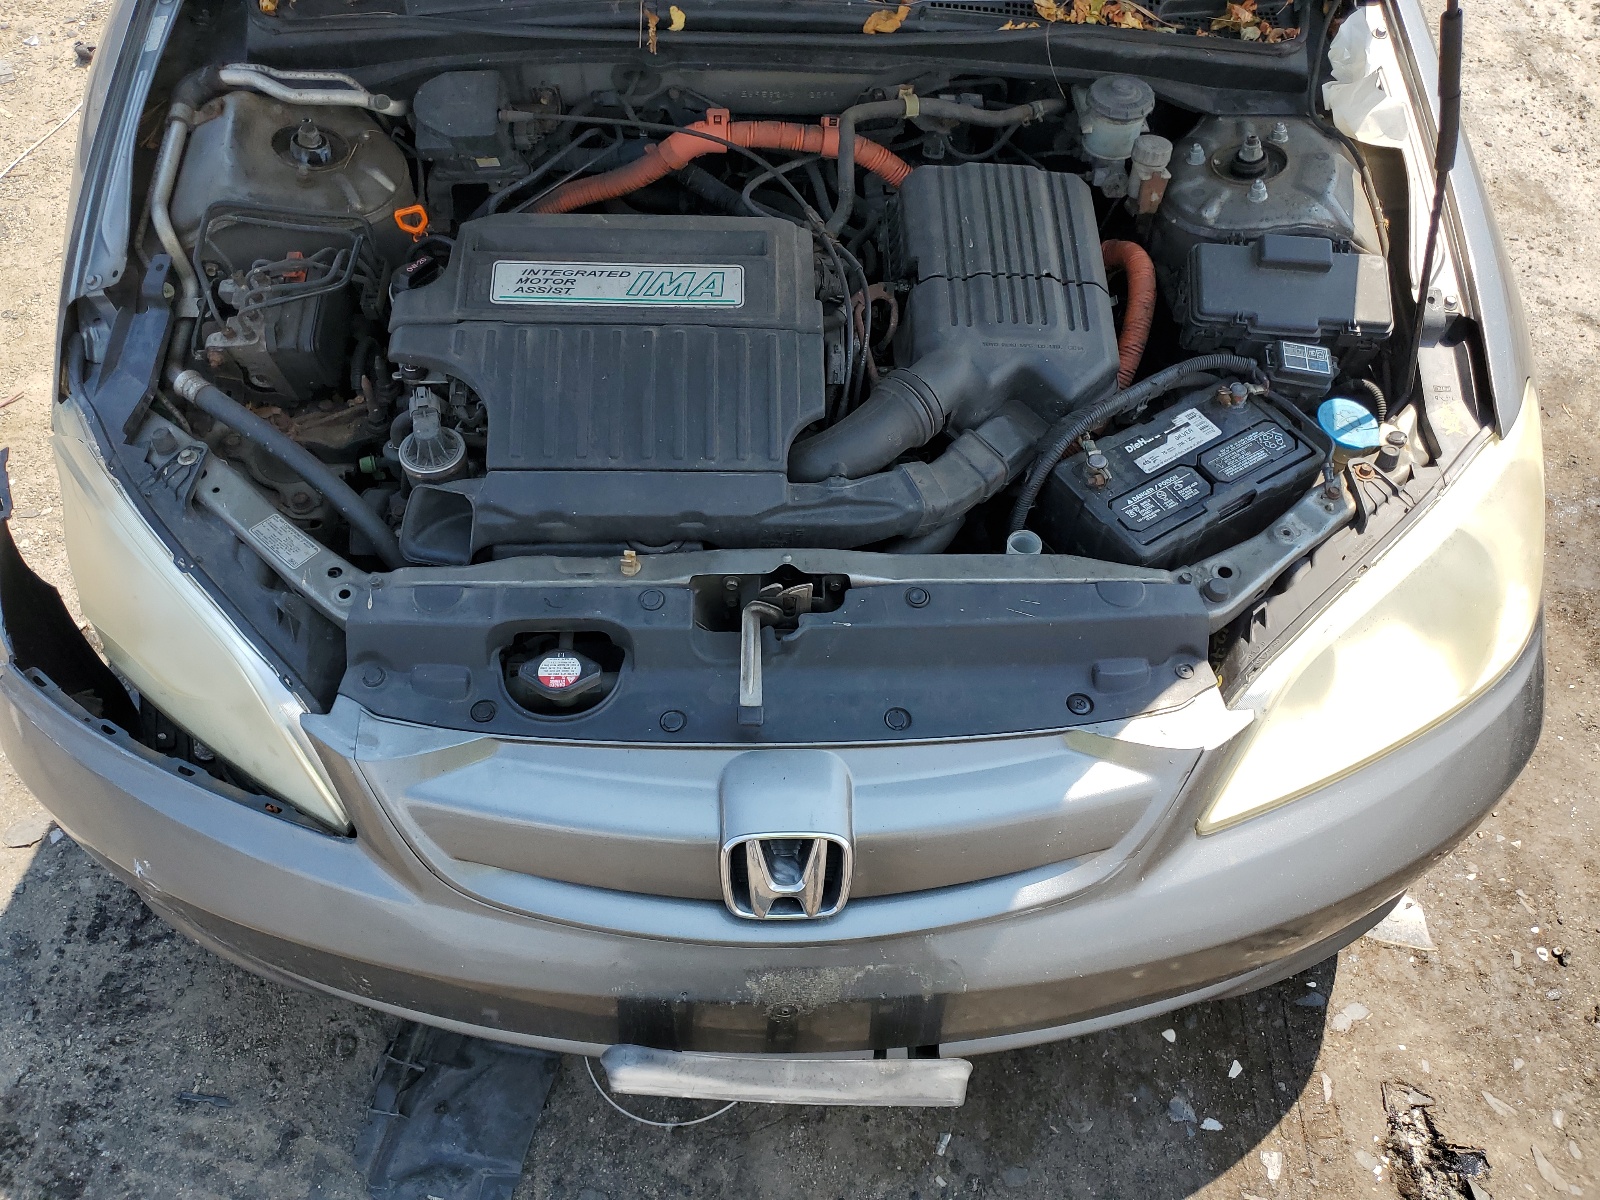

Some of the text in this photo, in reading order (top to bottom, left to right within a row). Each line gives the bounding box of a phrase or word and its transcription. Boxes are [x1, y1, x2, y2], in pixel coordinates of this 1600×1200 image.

[521, 268, 632, 278] INTEGRATED
[515, 277, 577, 286] MOTOR
[626, 270, 725, 297] IMA
[513, 286, 576, 296] ASSIST
[1131, 488, 1156, 502] DANGER
[1157, 474, 1179, 488] POISON
